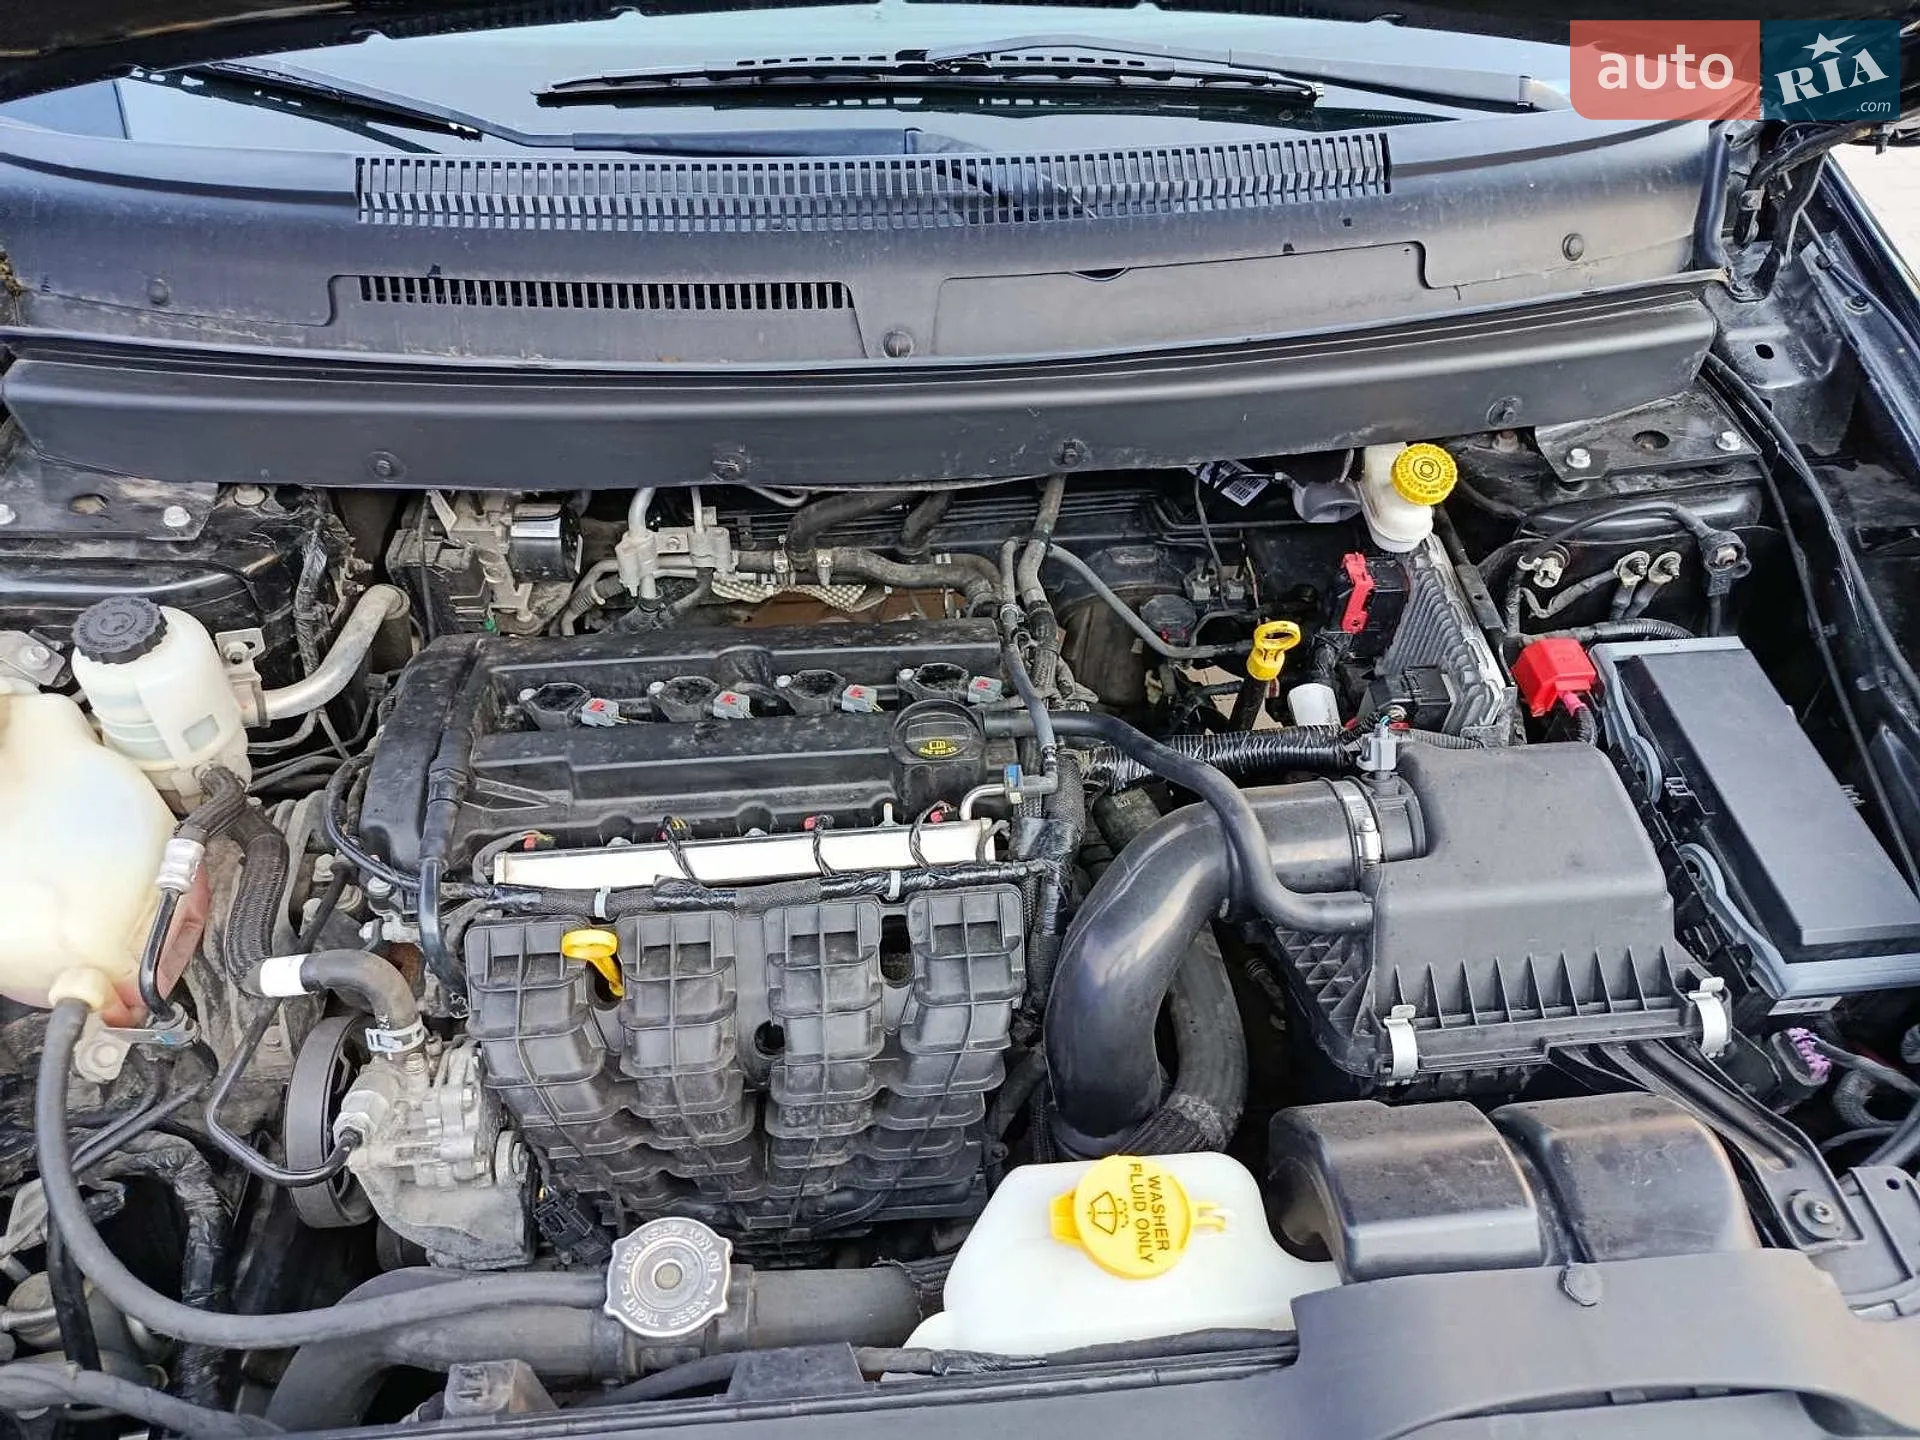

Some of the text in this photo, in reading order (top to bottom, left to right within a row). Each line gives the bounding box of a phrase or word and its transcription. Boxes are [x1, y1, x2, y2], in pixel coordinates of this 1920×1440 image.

[1128, 1163, 1154, 1264] FLUID ONLY
[1148, 1175, 1170, 1251] WASHER
